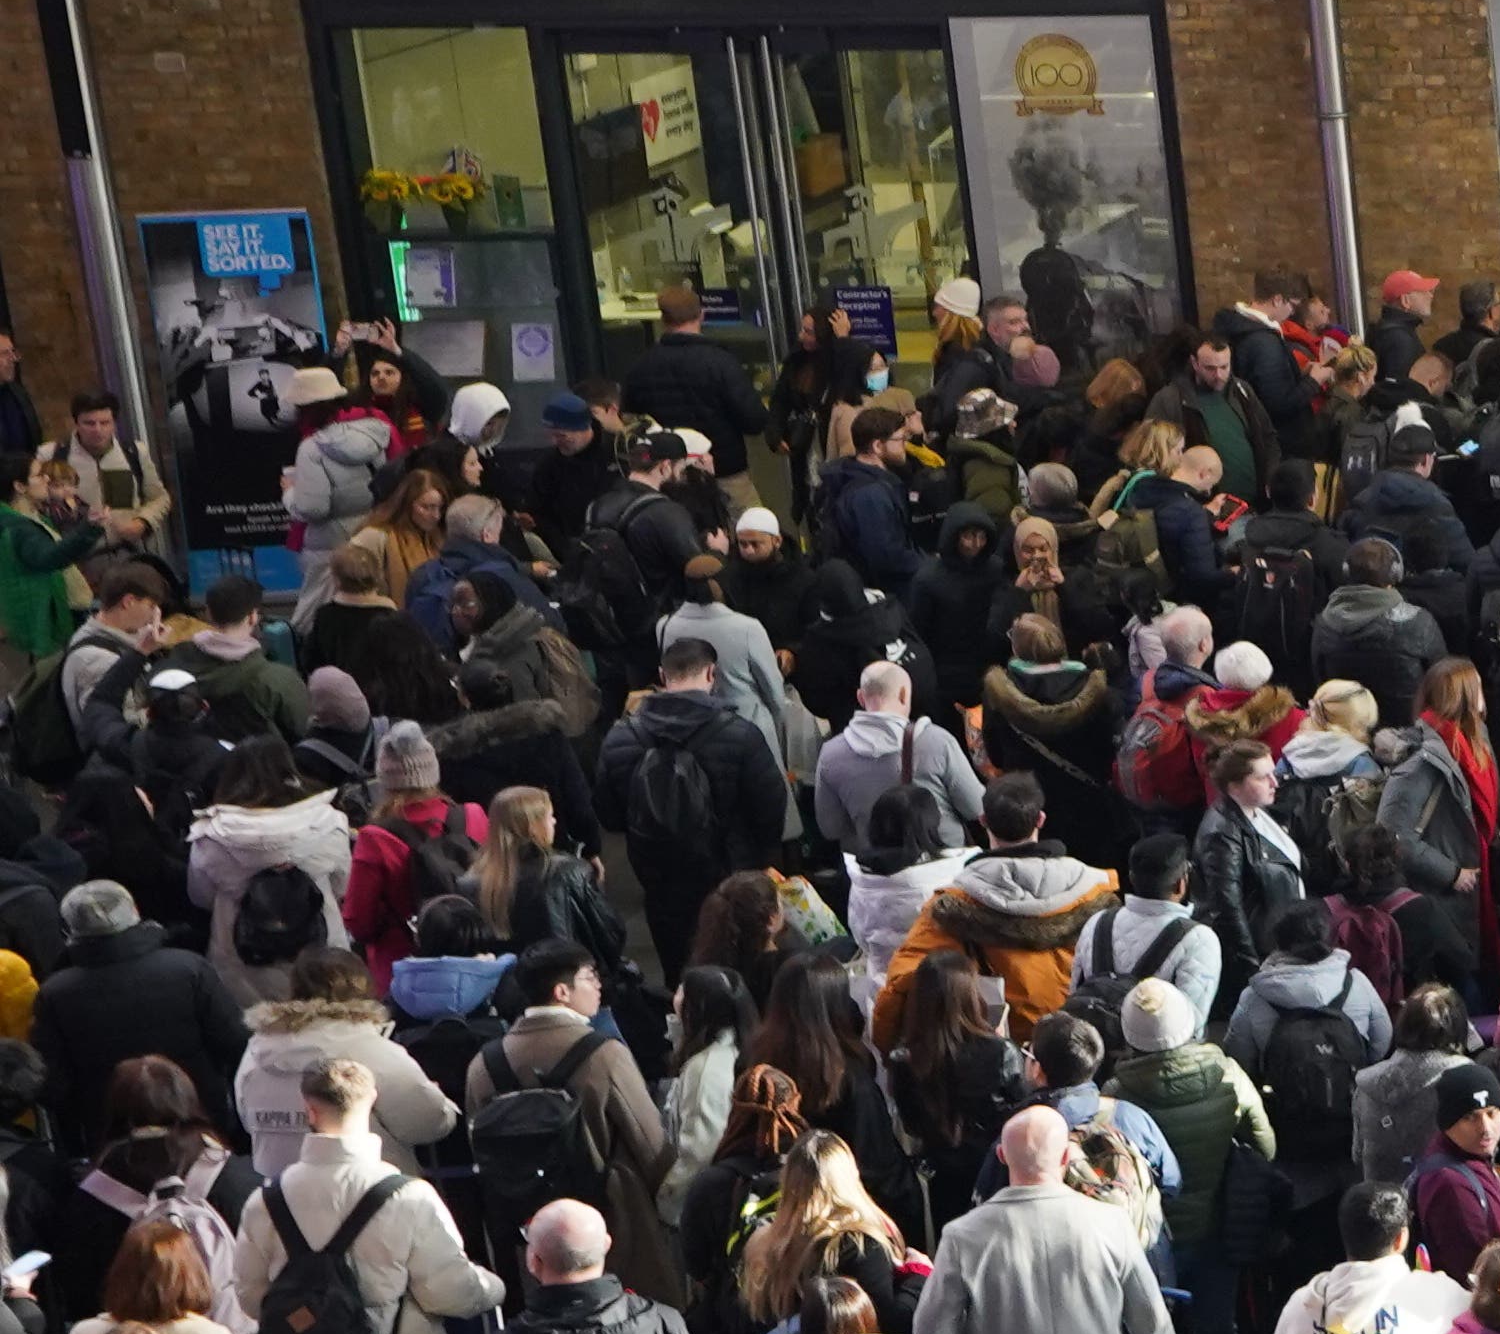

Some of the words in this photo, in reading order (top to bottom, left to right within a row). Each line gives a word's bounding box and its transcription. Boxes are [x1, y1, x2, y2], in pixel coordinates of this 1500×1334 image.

[203, 223, 237, 237] SEE
[242, 223, 263, 238] IT.
[205, 239, 241, 255] SAY
[207, 254, 290, 272] SORTED.
